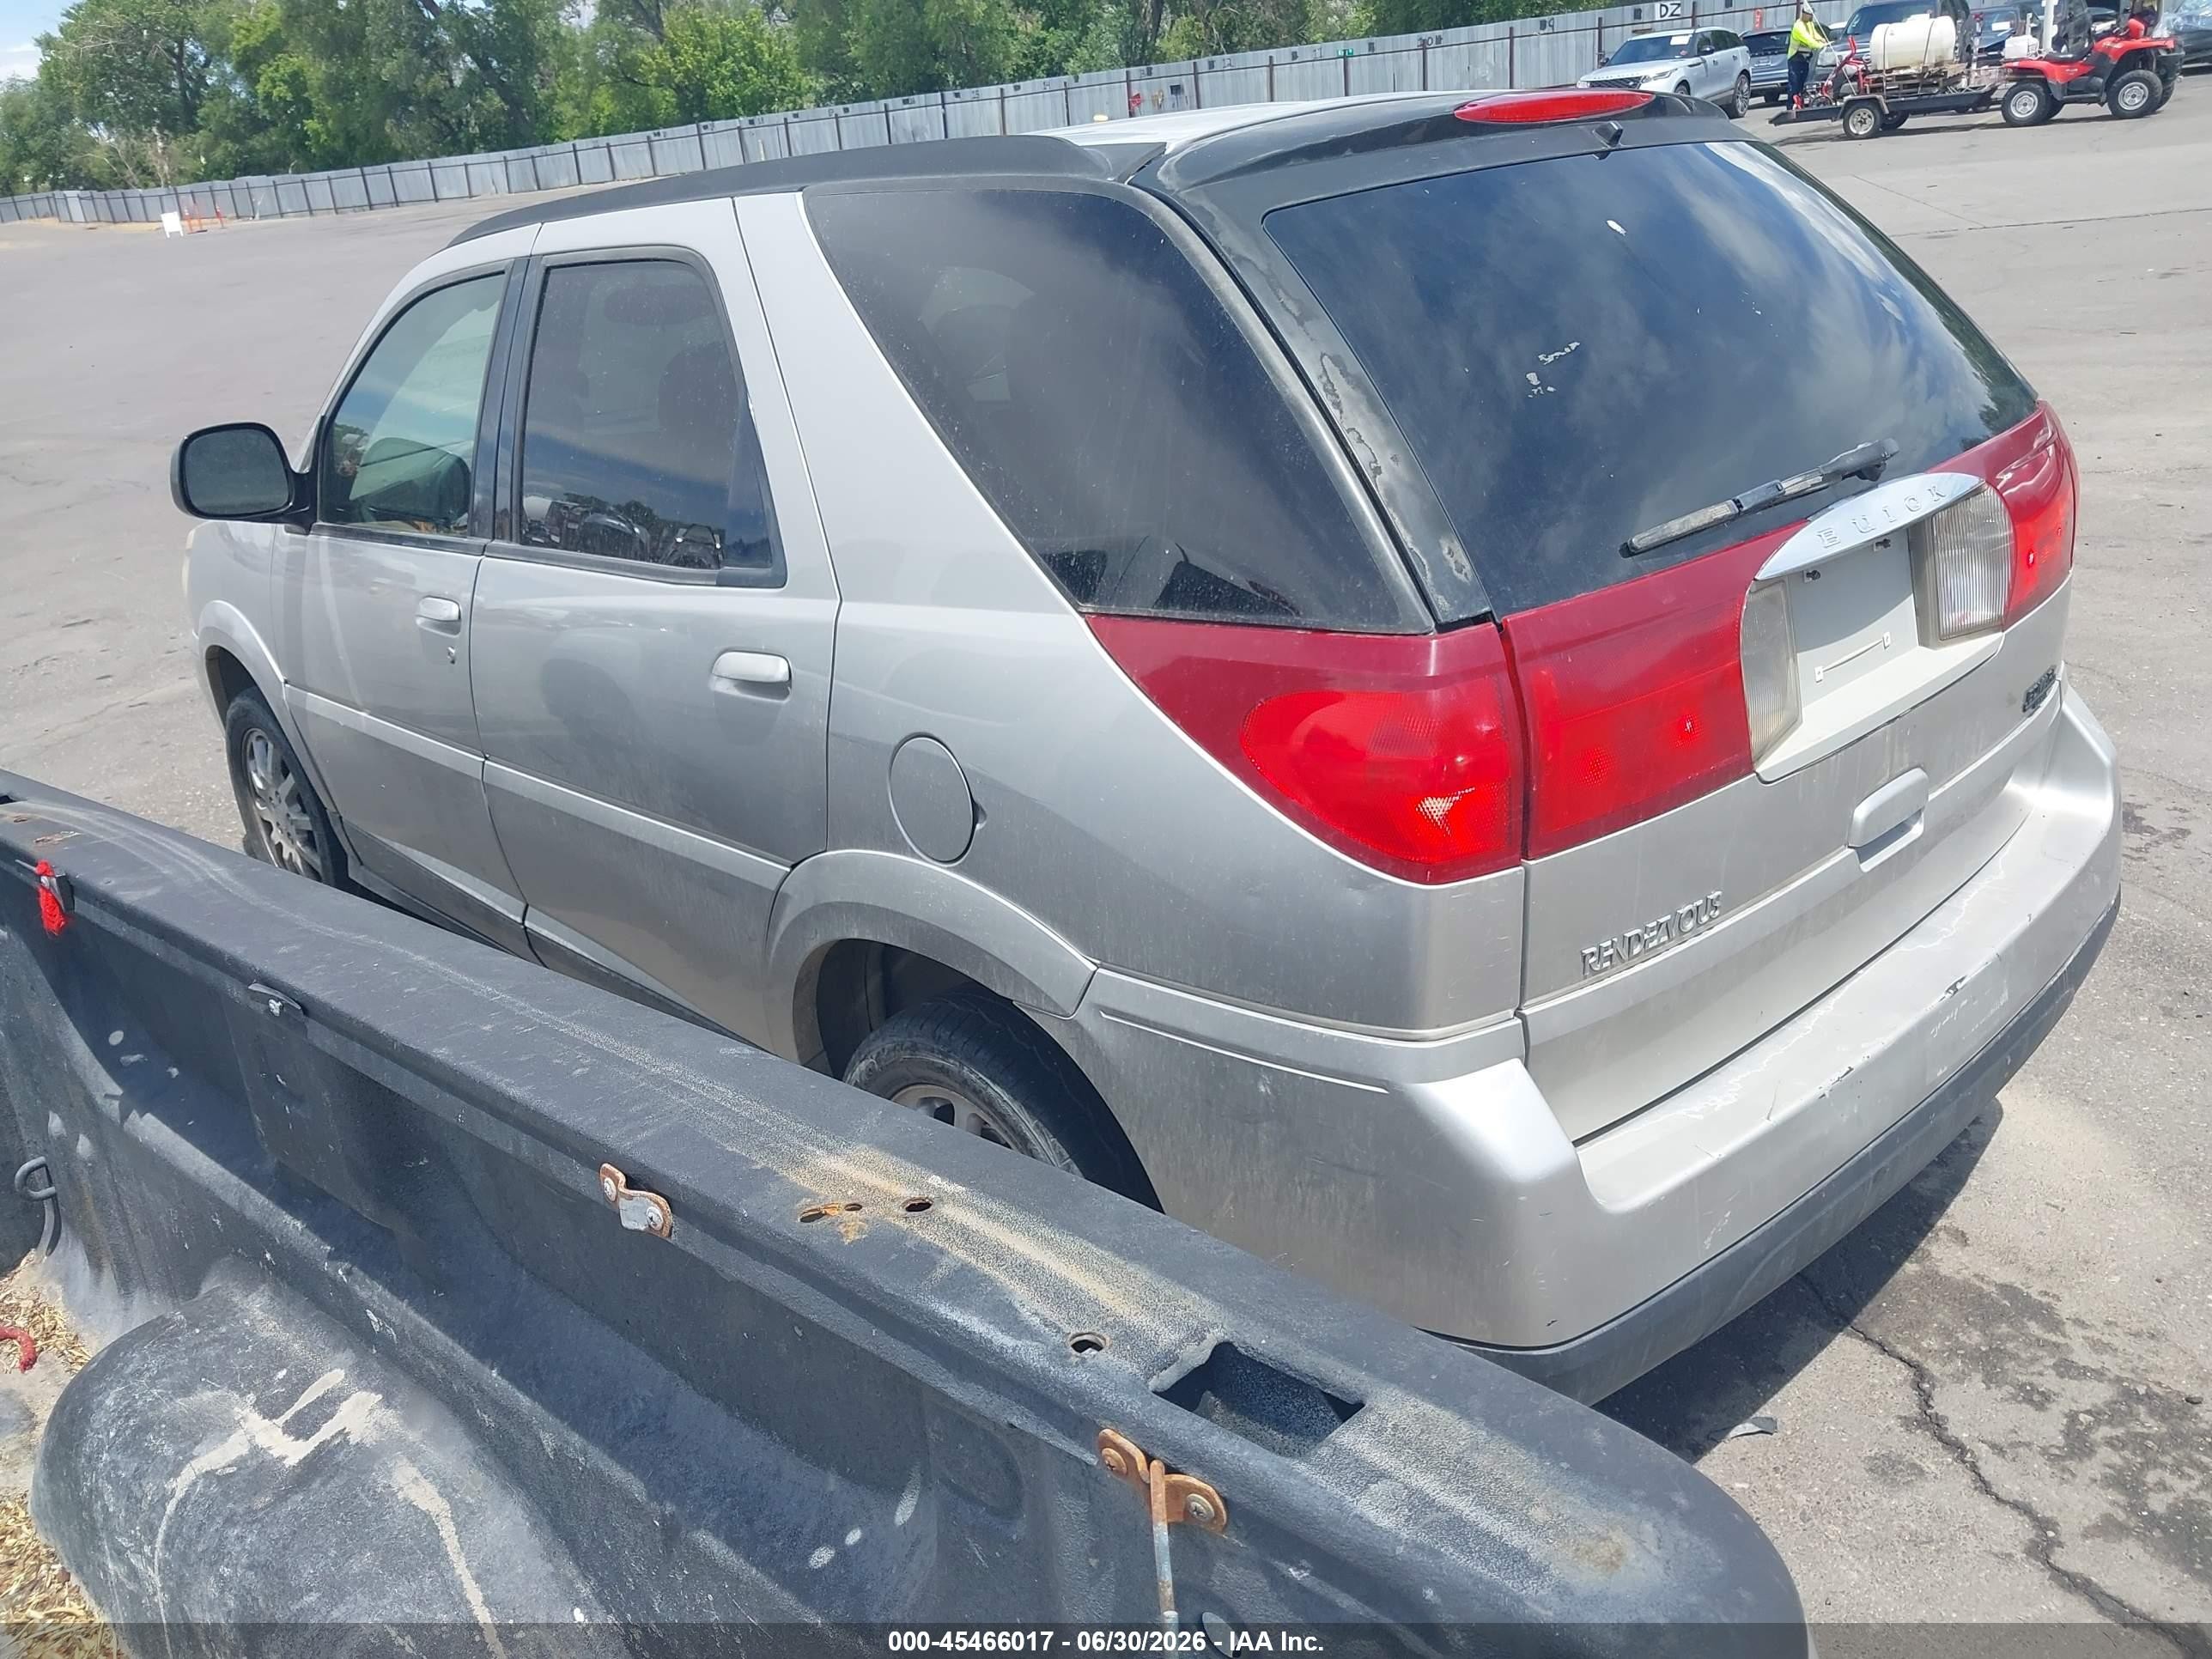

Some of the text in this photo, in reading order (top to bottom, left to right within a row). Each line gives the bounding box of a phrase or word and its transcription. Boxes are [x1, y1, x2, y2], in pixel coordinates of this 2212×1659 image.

[1660, 3, 1681, 18] DZ
[1817, 484, 1948, 550] BUICK
[1582, 890, 1723, 975] RENDEZVOUS
